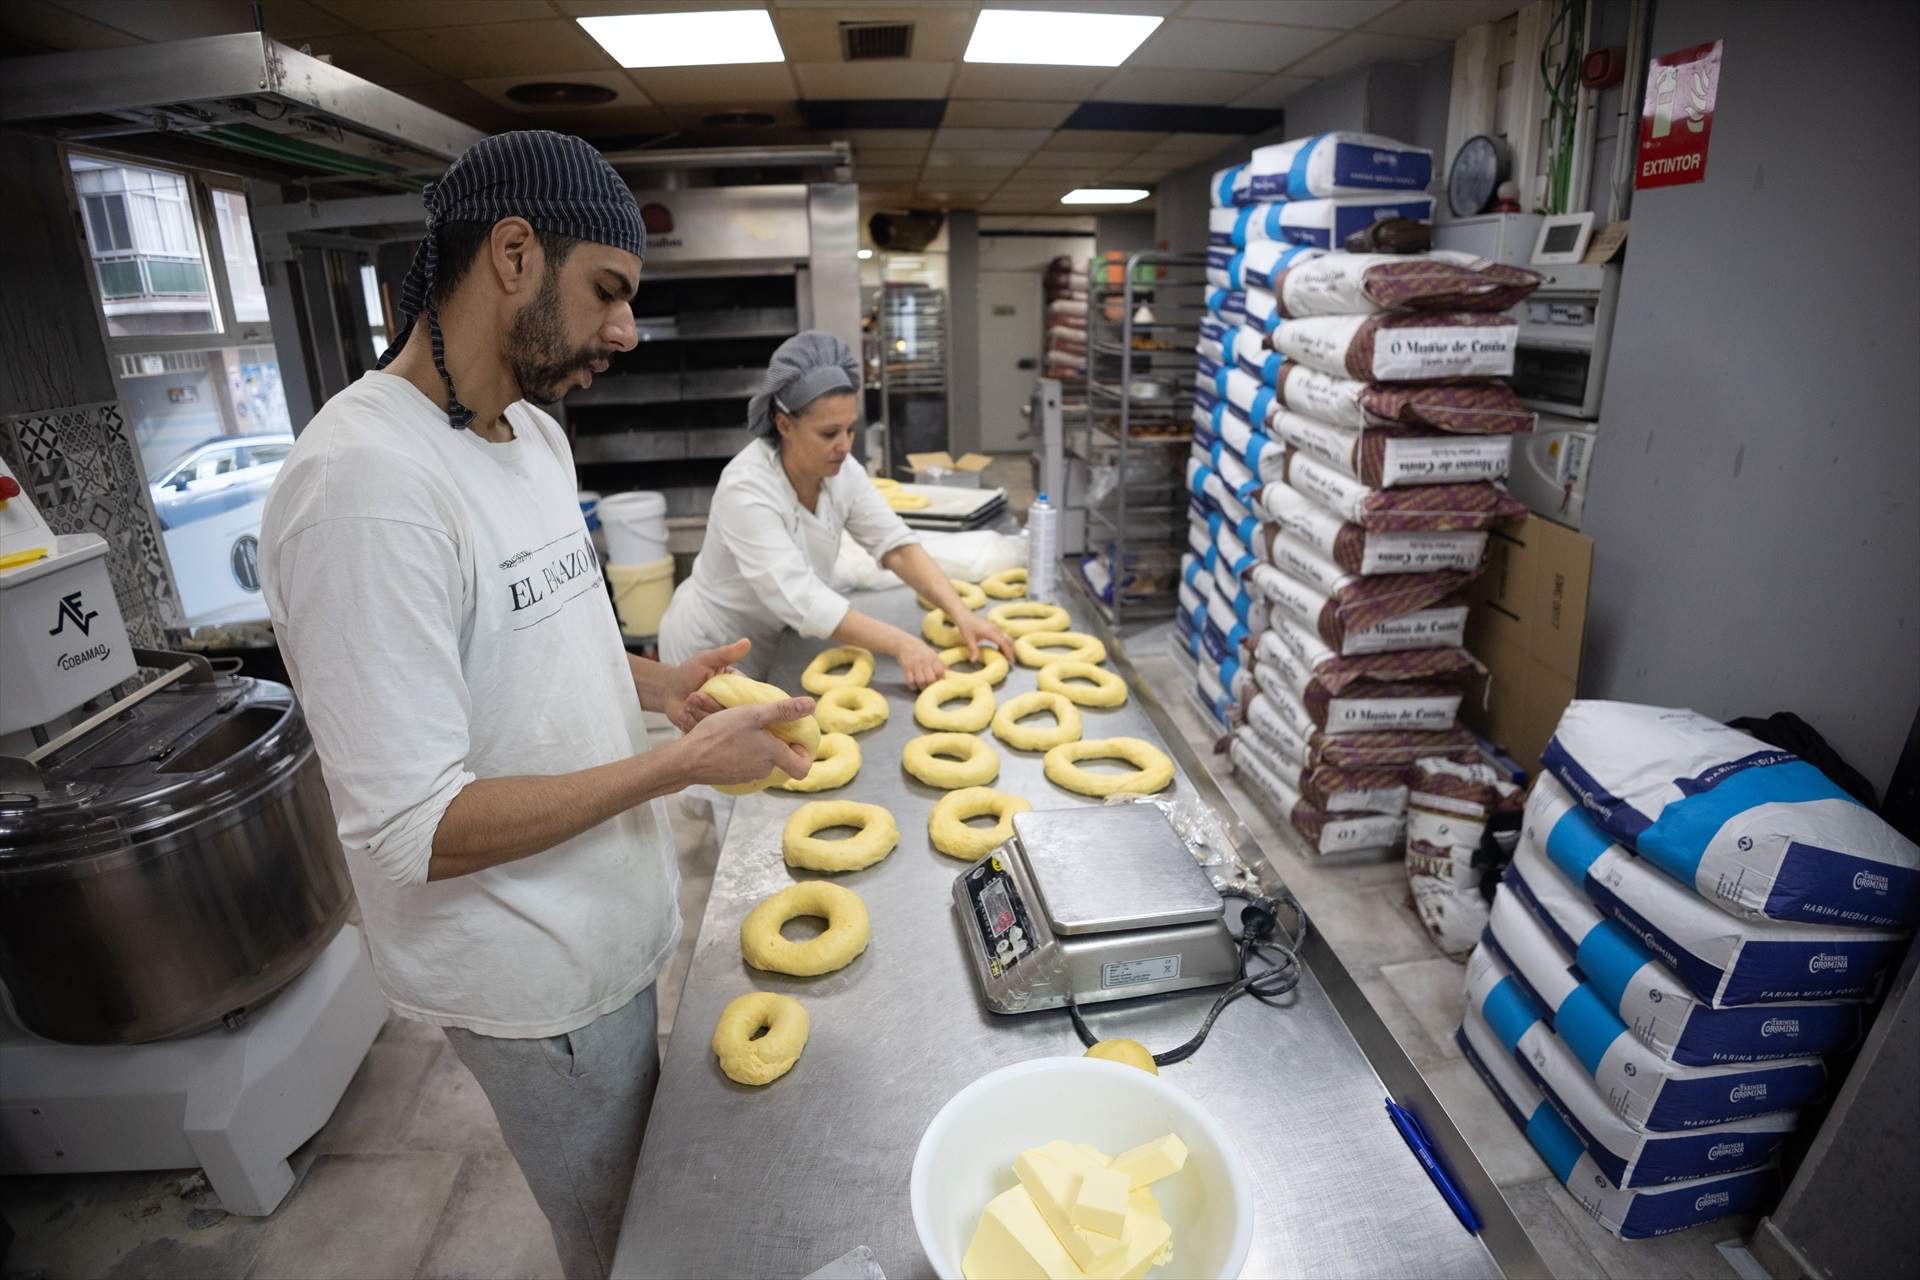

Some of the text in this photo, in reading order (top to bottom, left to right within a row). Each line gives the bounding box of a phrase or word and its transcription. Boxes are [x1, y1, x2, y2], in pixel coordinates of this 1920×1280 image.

[1642, 153, 1701, 177] EXTINTOR
[1390, 341, 1401, 354] O
[1452, 340, 1467, 353] de
[508, 577, 543, 612] EL
[1344, 709, 1356, 720] O
[1400, 709, 1413, 720] de
[1852, 872, 1889, 891] COROMINA
[1802, 903, 1839, 917] HARINA
[1840, 909, 1869, 922] MEDIA
[1808, 955, 1848, 974] COROMINA
[1760, 990, 1799, 999] FARINA
[1761, 1020, 1800, 1038] COROMINA
[1712, 1052, 1752, 1062] HARINA
[1729, 1086, 1767, 1103] COROMINA
